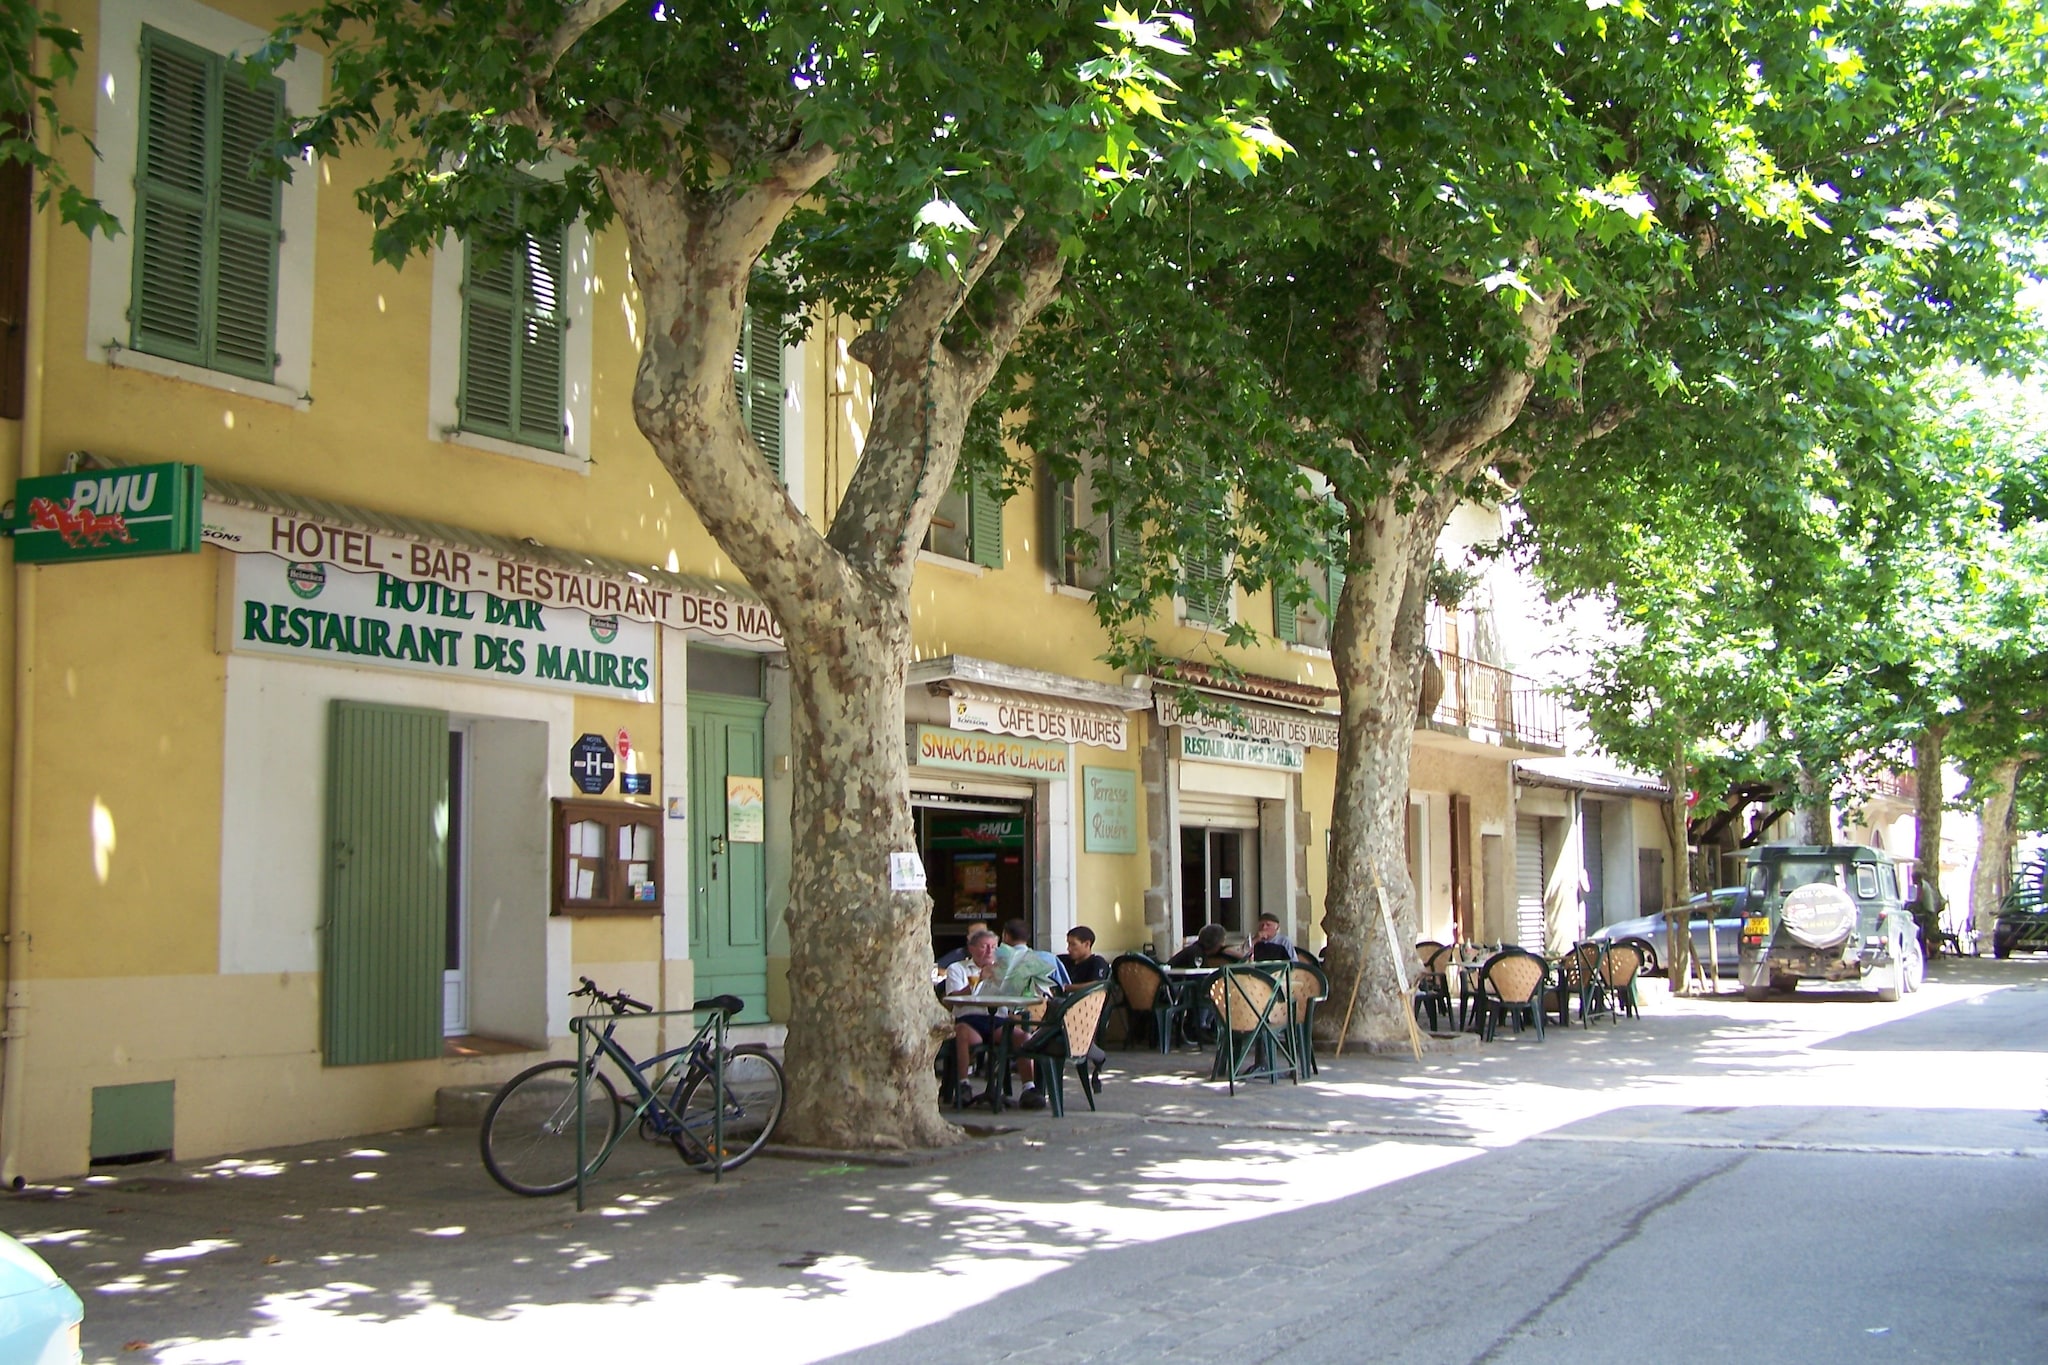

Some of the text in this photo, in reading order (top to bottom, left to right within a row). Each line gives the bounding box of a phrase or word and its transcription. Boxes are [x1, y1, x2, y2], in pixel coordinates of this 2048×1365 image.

[72, 473, 157, 515] PMU
[271, 516, 384, 570] HOTEL
[411, 544, 471, 585] BAR
[497, 561, 672, 619] RESTAURANT
[683, 596, 728, 630] DES
[737, 605, 784, 638] MAU
[290, 569, 324, 582] Heineken
[376, 572, 546, 631] HOTEL BAR
[592, 618, 617, 630] Heineken
[243, 600, 649, 691] RESTAURANT DES MAURES
[998, 706, 1122, 745] CAFE DES MAURES
[1289, 723, 1306, 742] DES
[1309, 726, 1338, 746] MAURE
[586, 752, 602, 776] H
[1184, 736, 1245, 760] RESTAURANT
[1249, 744, 1264, 763] DES
[1267, 746, 1302, 768] MAURES
[1091, 777, 1128, 804] Terrasse
[977, 822, 1012, 837] PMU
